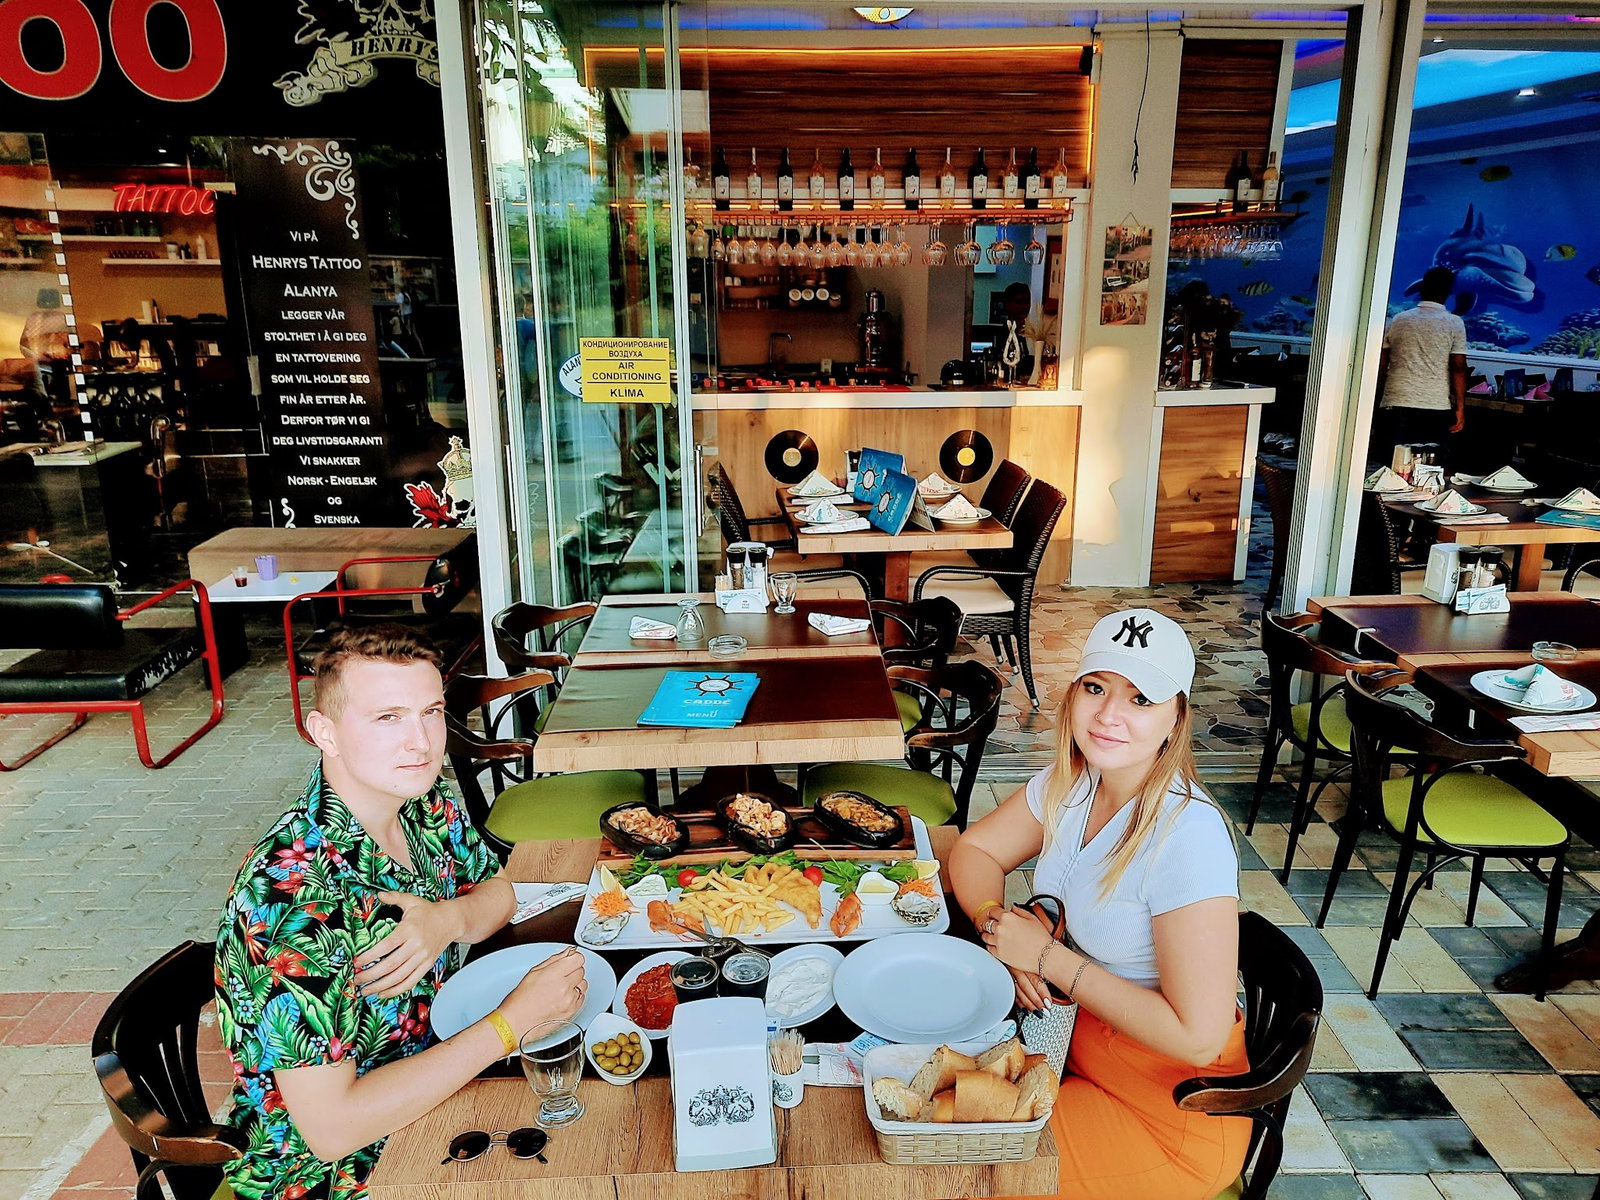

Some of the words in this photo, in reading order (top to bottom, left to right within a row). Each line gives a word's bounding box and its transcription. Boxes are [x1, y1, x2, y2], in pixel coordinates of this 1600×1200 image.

[351, 37, 438, 60] HENRYS
[304, 229, 319, 242] PÅ
[252, 255, 308, 269] HENRYS
[309, 256, 362, 270] TATTOO
[283, 283, 338, 298] ALANYA
[281, 310, 323, 320] LEGGER
[325, 308, 346, 320] VÅR
[264, 332, 316, 341] STOLTHET
[318, 332, 321, 341] I
[323, 329, 332, 341] Å
[333, 332, 344, 341] GI
[346, 332, 367, 341] DEG
[583, 341, 668, 349] КОНДИЦИОНИРОВАНИЕ
[275, 353, 290, 363] EN
[291, 353, 361, 363] TATTOVERING
[618, 362, 635, 370] AIR
[271, 374, 294, 384] SOM
[295, 374, 313, 384] VIL
[313, 374, 348, 384] HOLDE
[349, 374, 371, 384] SEG
[592, 372, 662, 381] CONDITIONING
[280, 395, 297, 405] FIN
[299, 392, 314, 405] ÅR
[315, 395, 348, 405] ETTER
[349, 392, 367, 405] ÅR.
[281, 414, 324, 425] DERFOR
[325, 415, 346, 426] TØR
[347, 416, 358, 425] VI
[359, 416, 371, 425] GI
[272, 436, 294, 446] DEG
[295, 436, 383, 446] LIVSTIDSGARANTI
[299, 455, 311, 466] VI
[312, 456, 361, 466] SNAKKER
[327, 496, 342, 505] OG
[313, 514, 360, 524] SVENSKA
